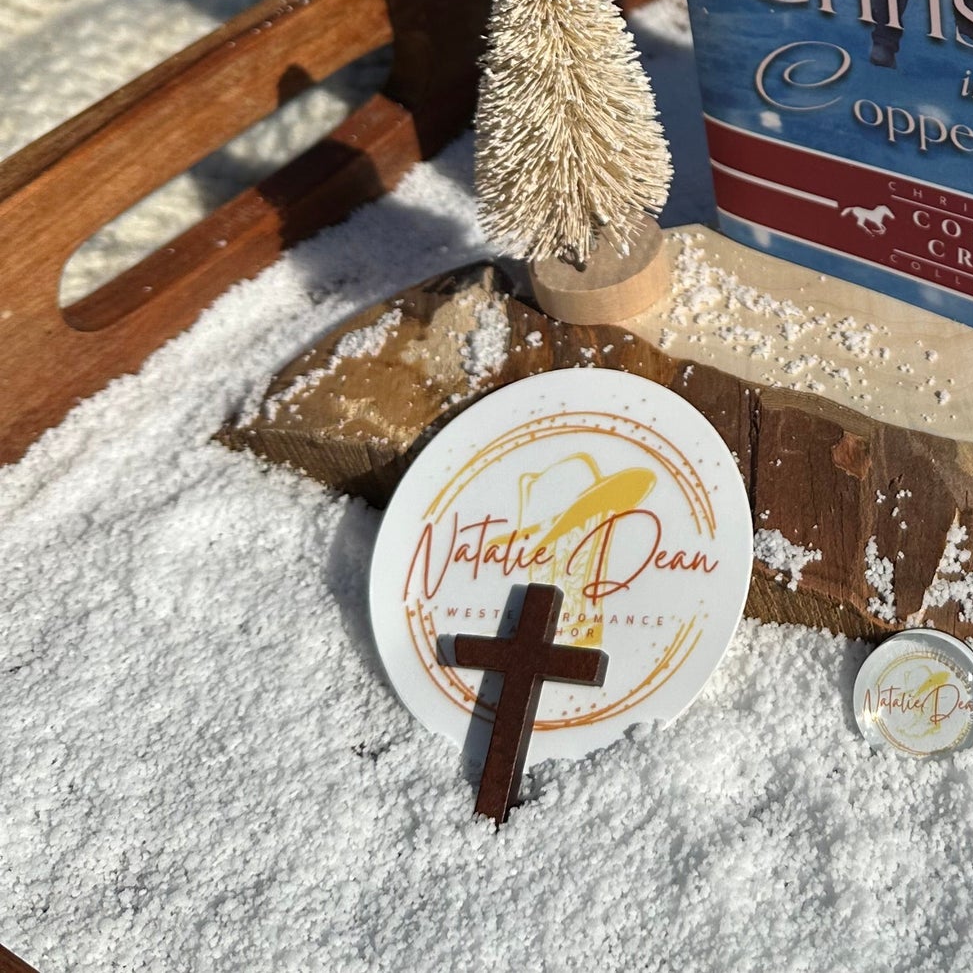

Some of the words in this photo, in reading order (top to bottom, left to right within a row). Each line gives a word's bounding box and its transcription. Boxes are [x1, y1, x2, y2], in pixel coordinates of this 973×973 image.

[403, 512, 553, 601] Natalie
[566, 508, 719, 606] Dean
[446, 607, 514, 621] WESTE
[562, 612, 665, 626] ROMANCE
[863, 684, 922, 715] Natalie
